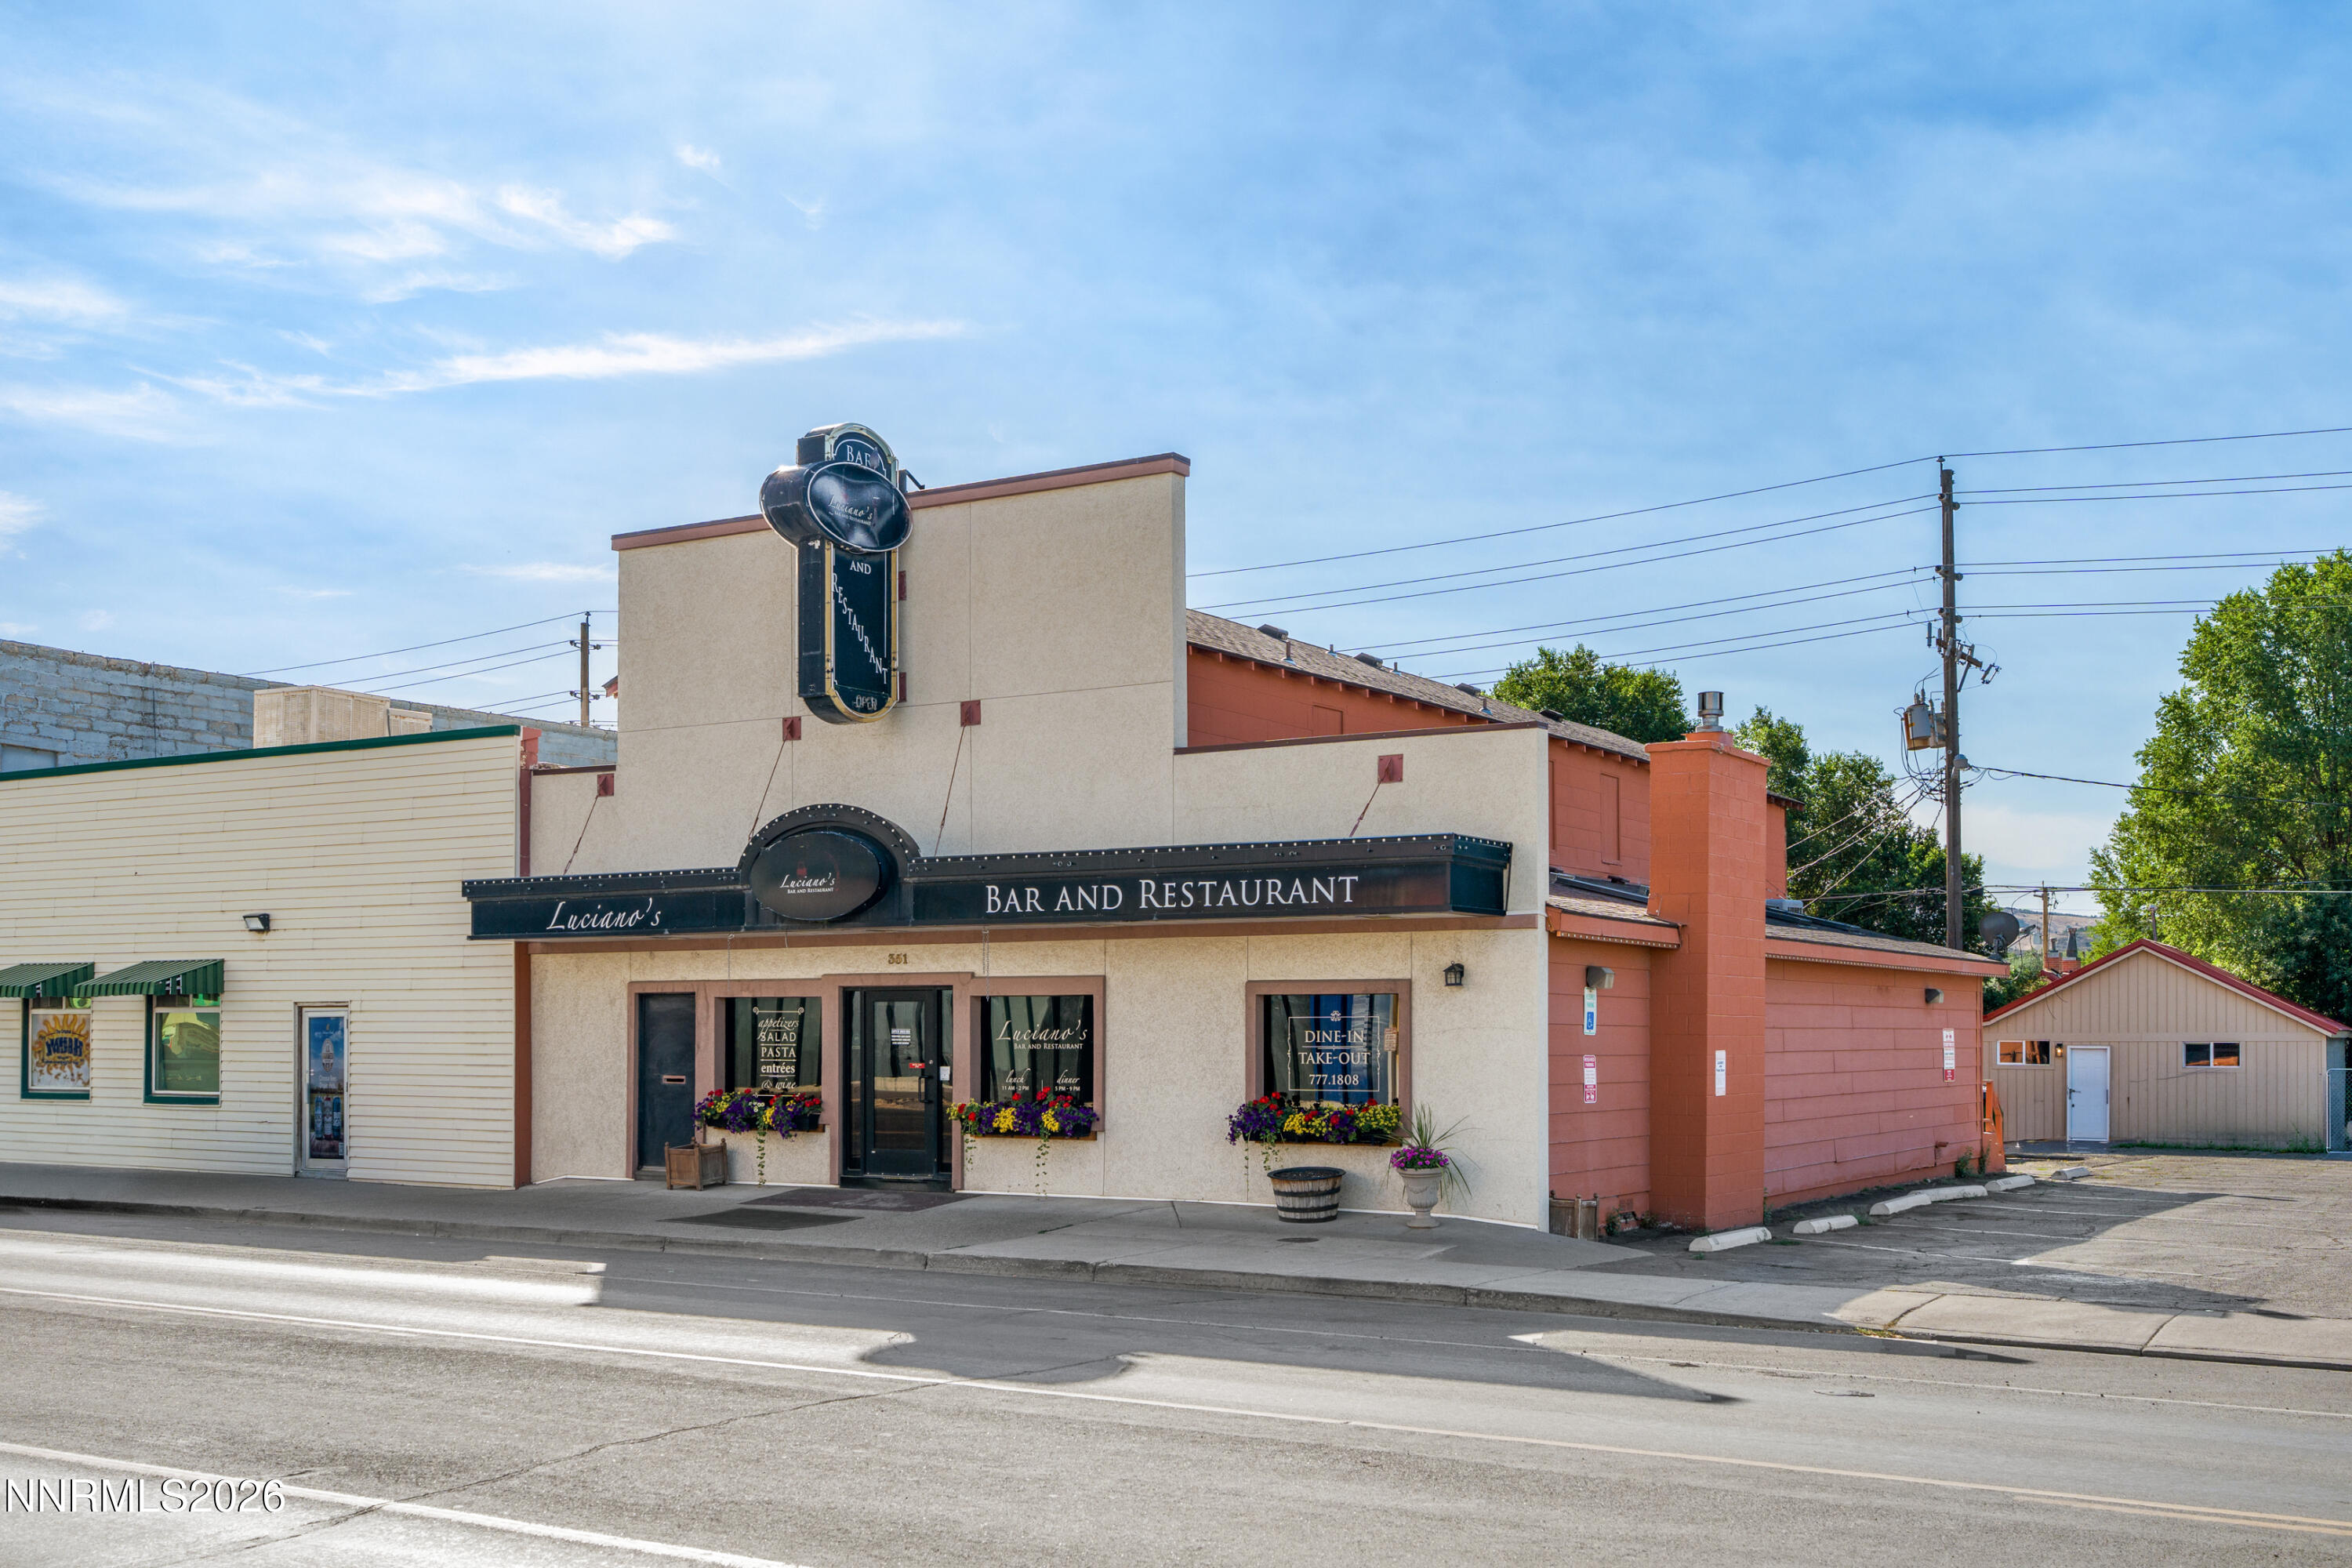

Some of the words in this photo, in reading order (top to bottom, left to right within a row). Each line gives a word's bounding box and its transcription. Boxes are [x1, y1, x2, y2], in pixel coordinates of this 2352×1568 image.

[846, 445, 872, 466] BAR
[850, 560, 872, 575] AND
[832, 572, 887, 684] RESTAURANT
[781, 872, 836, 888] Luciano's
[985, 884, 1045, 914] BAR
[1054, 884, 1123, 912] AND
[1138, 875, 1359, 909] RESTAURANT
[546, 897, 662, 931] Luciano's
[757, 1017, 800, 1040] appetizers
[996, 1019, 1088, 1041] Luciano's
[760, 1032, 797, 1042] SALAD
[1305, 1030, 1364, 1043] DINE-IN
[761, 1047, 797, 1058] PASTA
[1298, 1051, 1370, 1065] TAKE-OUT
[760, 1062, 796, 1073] entrées
[1006, 1068, 1032, 1083] lunch
[1056, 1069, 1081, 1084] dinner
[1308, 1074, 1359, 1085] 777.1808
[775, 1078, 797, 1091] wine
